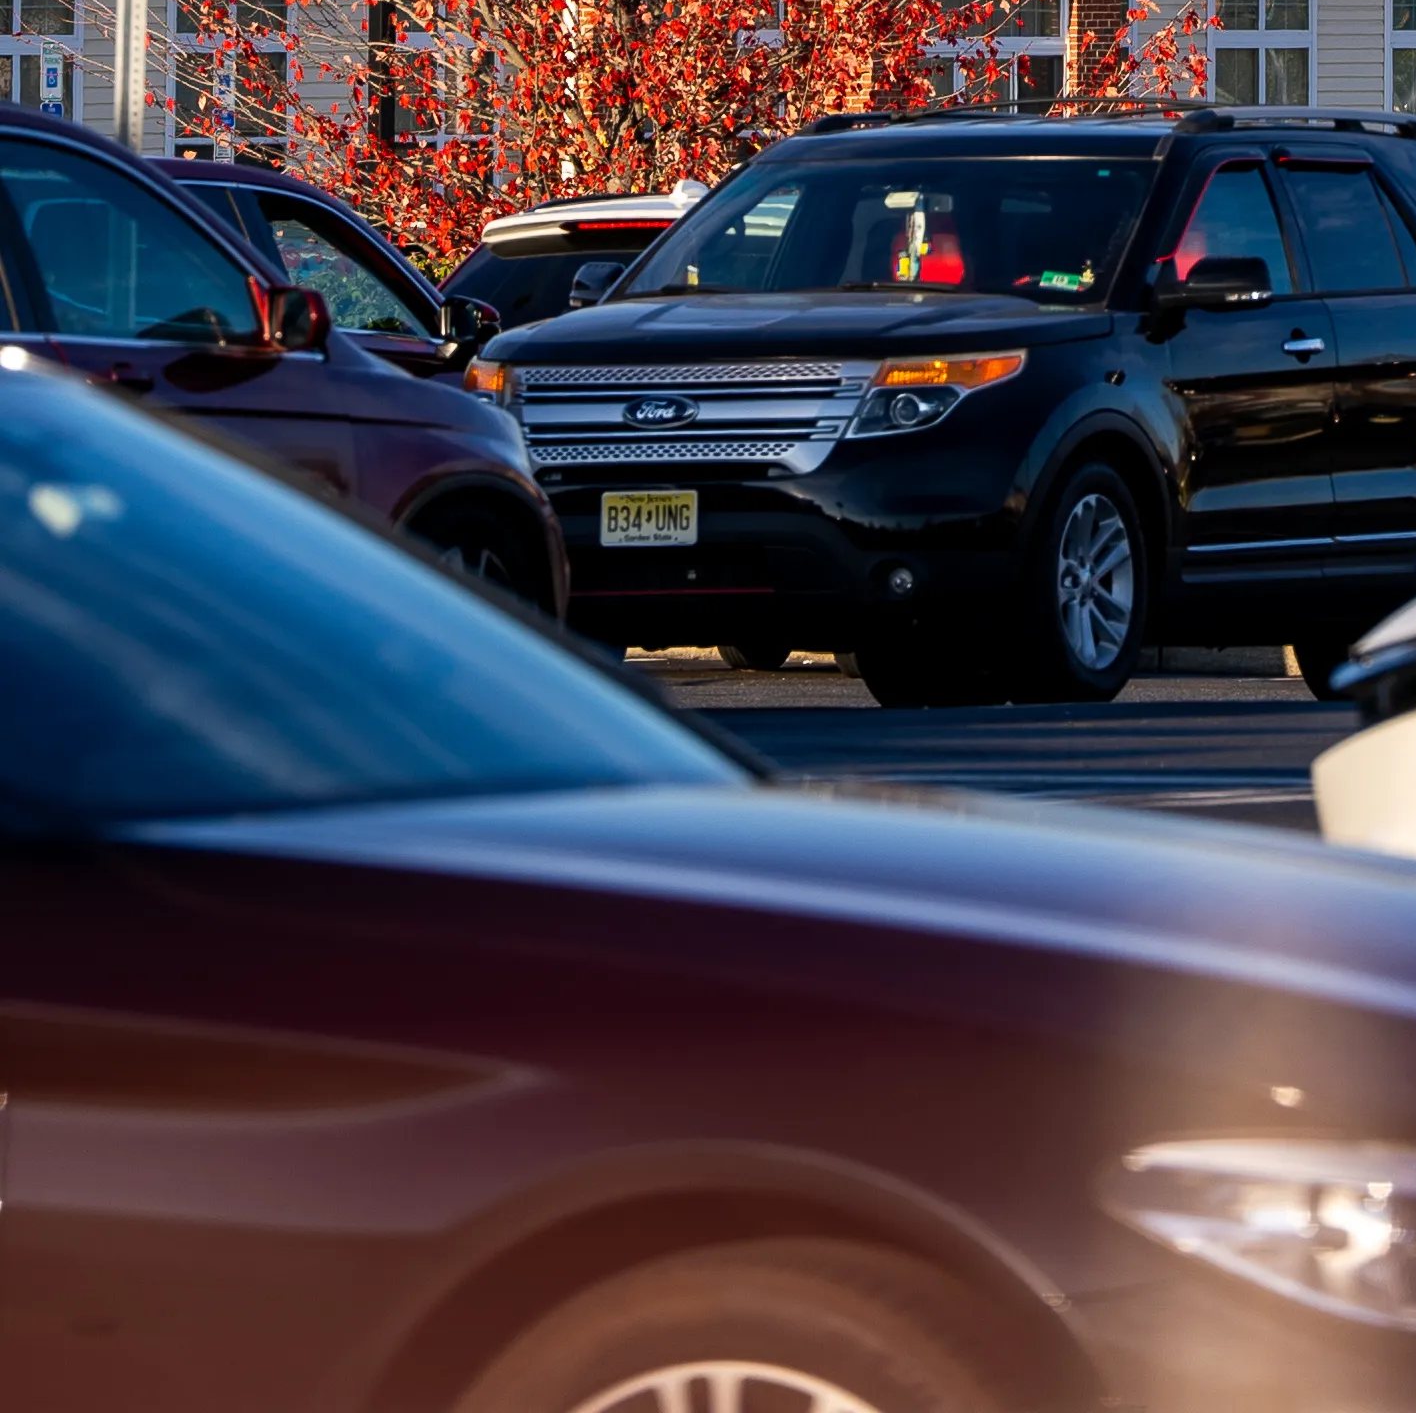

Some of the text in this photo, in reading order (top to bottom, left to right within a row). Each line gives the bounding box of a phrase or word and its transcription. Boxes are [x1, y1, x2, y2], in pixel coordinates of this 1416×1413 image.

[636, 401, 676, 419] Ford
[607, 504, 690, 533] B34 UNG
[624, 533, 672, 542] Garden State
